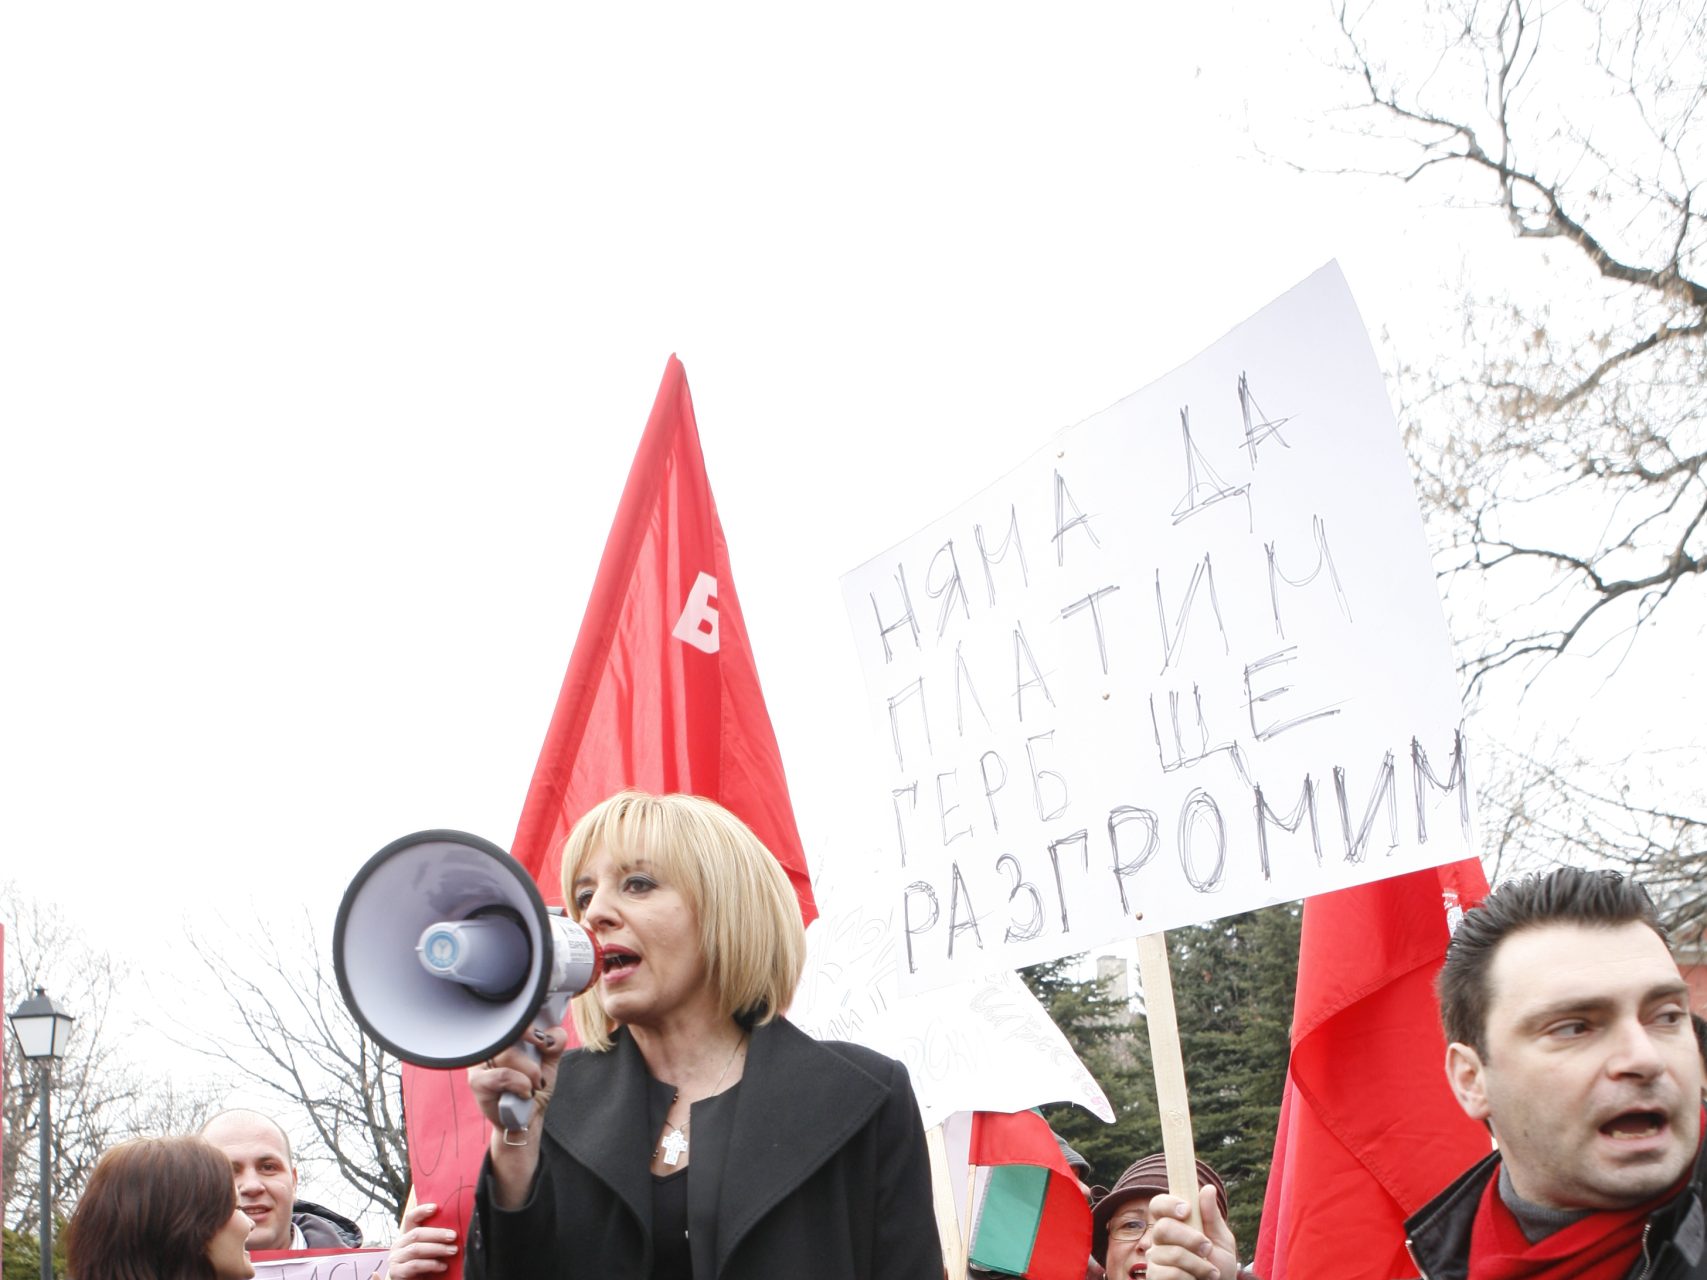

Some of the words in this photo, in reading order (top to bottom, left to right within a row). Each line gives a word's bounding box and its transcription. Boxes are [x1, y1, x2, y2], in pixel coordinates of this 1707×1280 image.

[869, 468, 1101, 664] НЯМА
[1171, 371, 1299, 533] ДА
[887, 514, 1353, 772] ПЛАТИМ
[892, 730, 1070, 868] ГЕРБ
[1150, 646, 1342, 788] ЩЕ
[904, 727, 1472, 974] РАЗГРОМИМ
